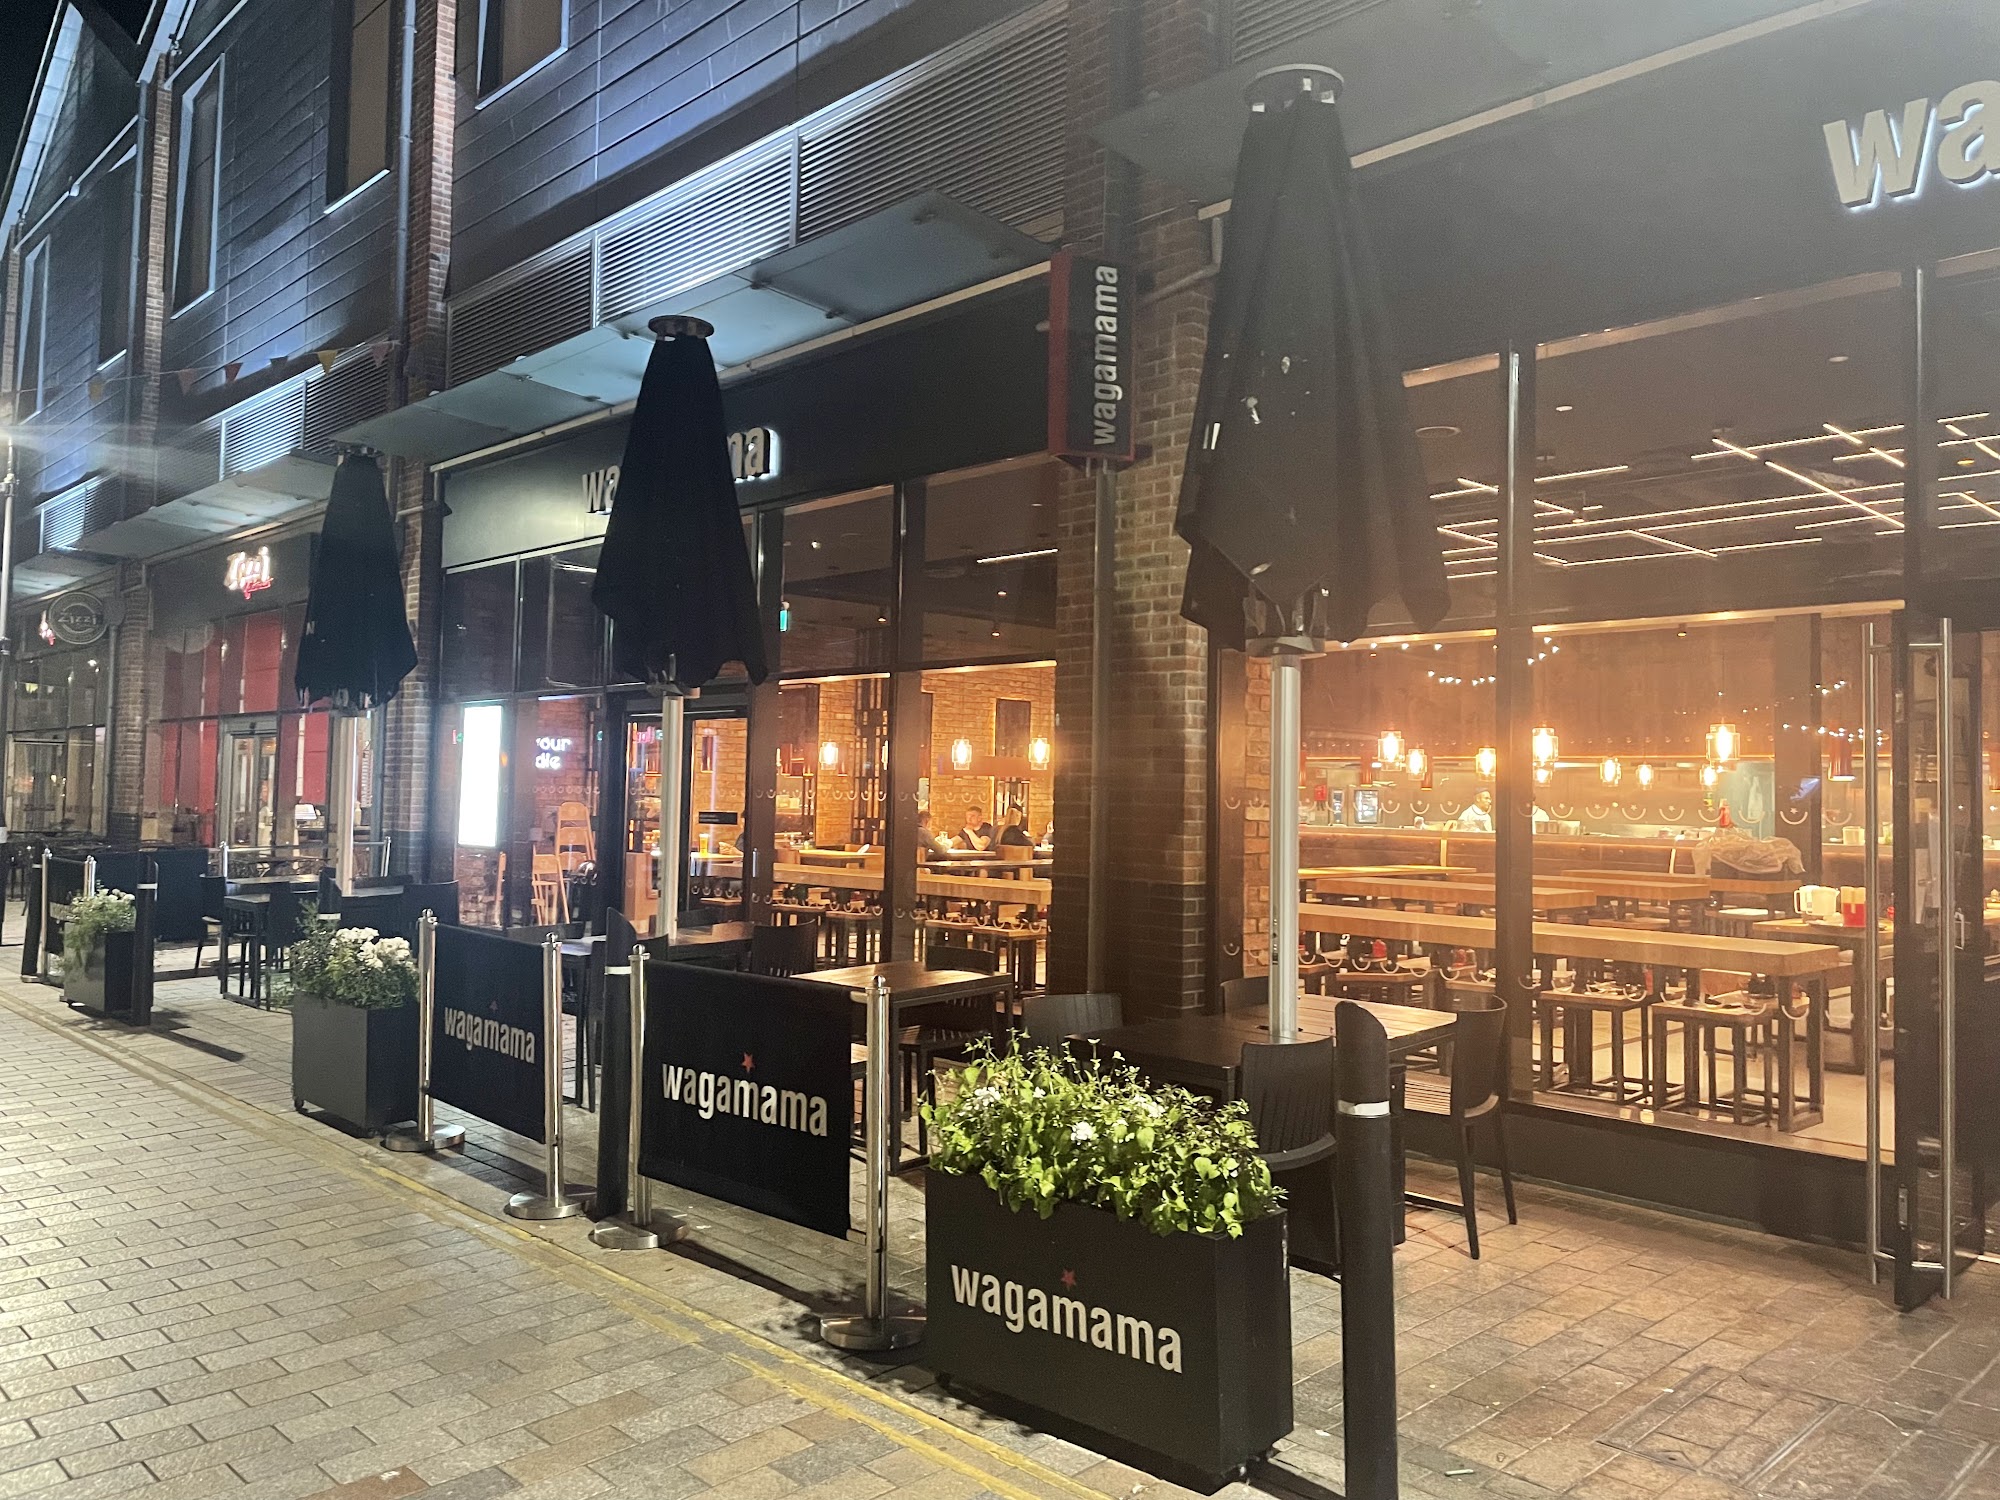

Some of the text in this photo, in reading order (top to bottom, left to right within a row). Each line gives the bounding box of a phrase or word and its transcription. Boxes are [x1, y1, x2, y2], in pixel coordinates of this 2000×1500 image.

[1093, 265, 1122, 445] wagamama
[444, 1007, 535, 1064] wagamama
[662, 1063, 827, 1137] wagamama
[951, 1264, 1182, 1373] wagamama
